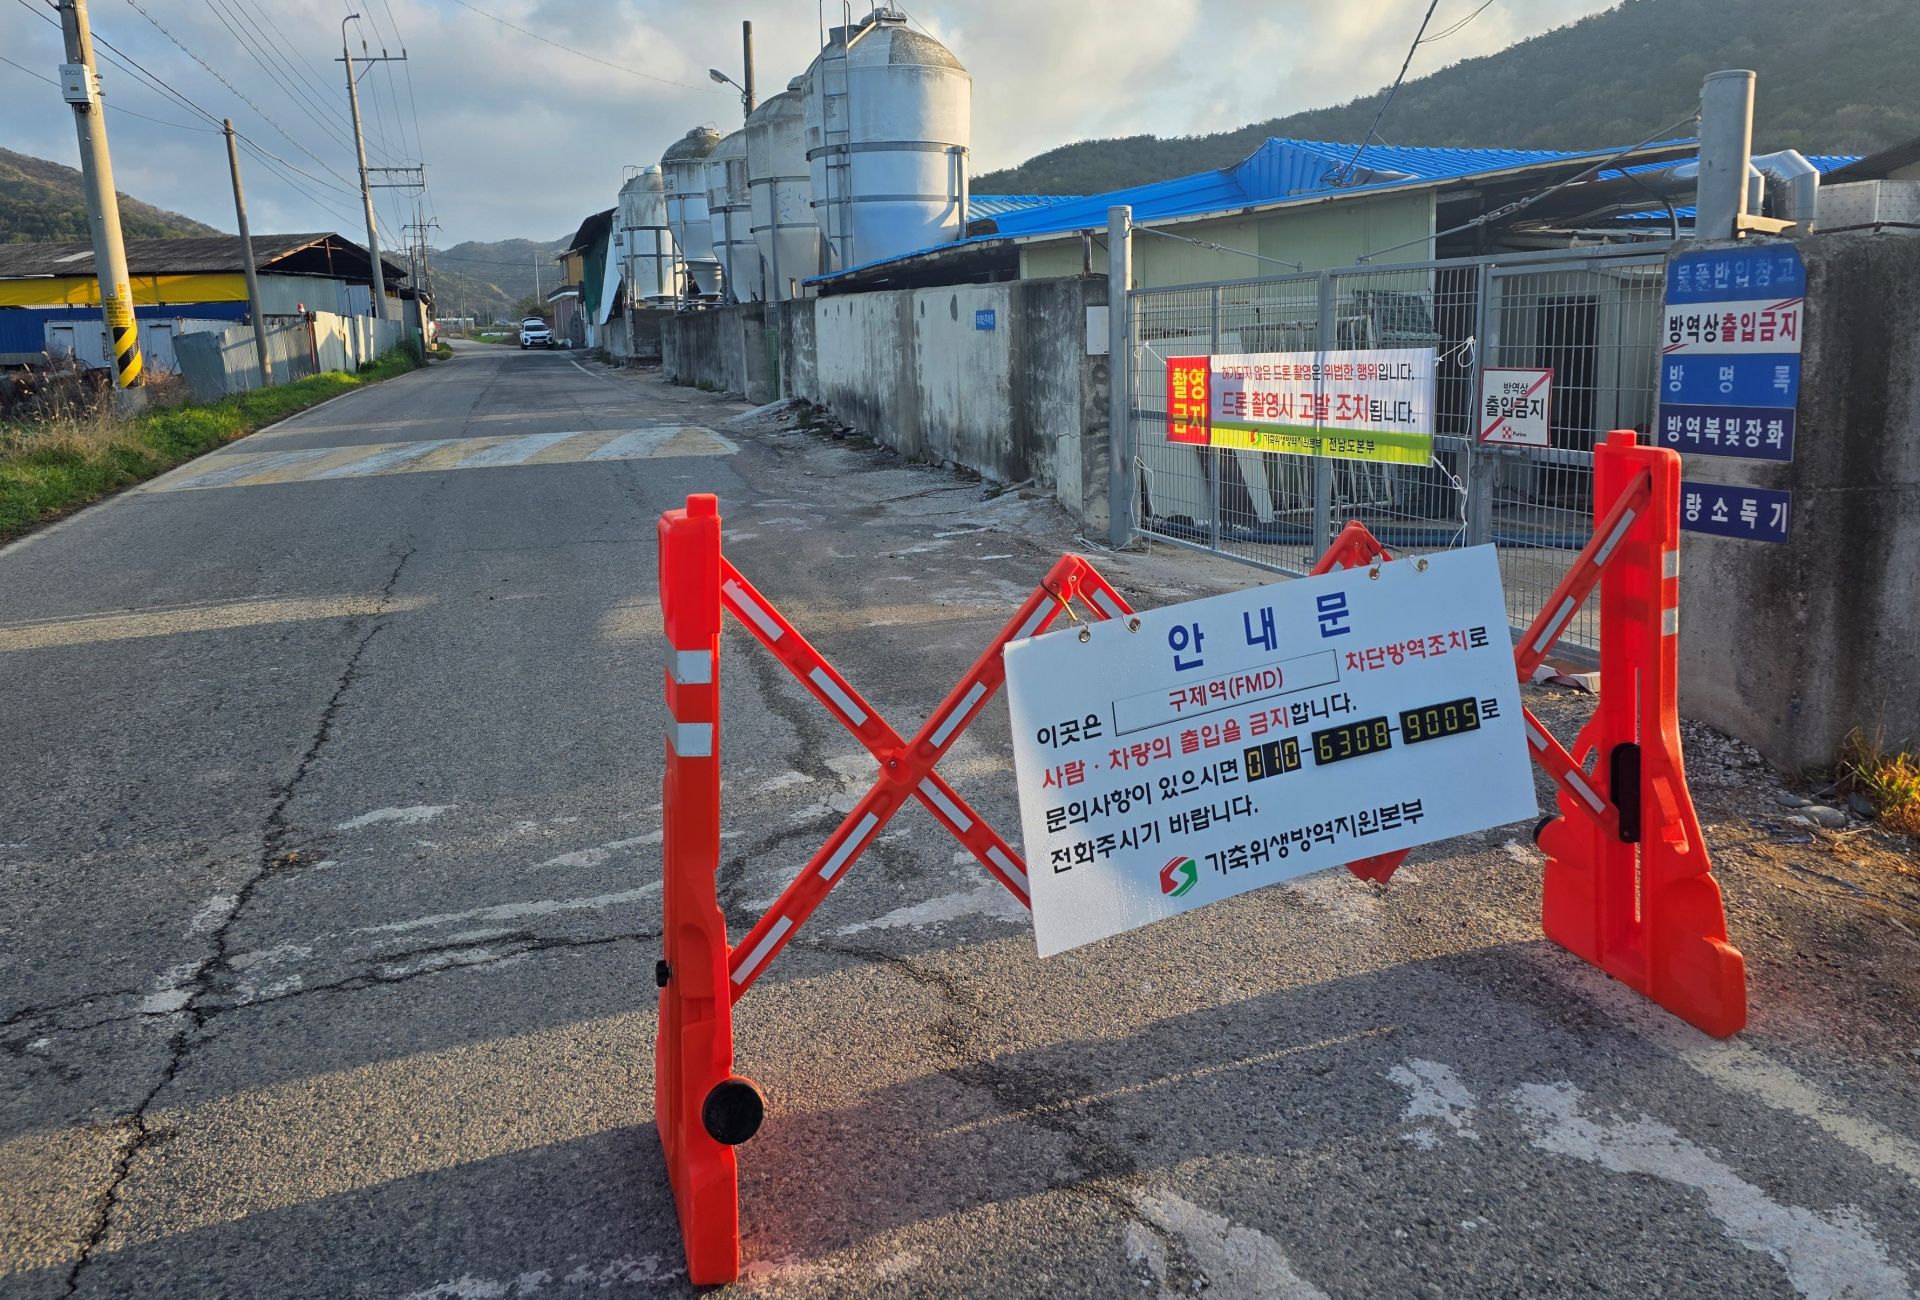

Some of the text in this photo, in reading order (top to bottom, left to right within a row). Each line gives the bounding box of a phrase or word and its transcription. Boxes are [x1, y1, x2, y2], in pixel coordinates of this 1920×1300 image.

[1669, 310, 1798, 344] 방역상출입금지
[1173, 367, 1205, 400] 촬영
[1254, 366, 1271, 381] 않은
[1273, 364, 1291, 381] 드론
[1293, 363, 1321, 381] 촬영은
[1324, 363, 1353, 381] 위법한
[1356, 363, 1415, 381] 행위입니다.
[1503, 382, 1528, 395] 방역상
[1173, 403, 1205, 435] 금지
[1222, 390, 1416, 424] 드론 촬영시 고발 조치됩니다.
[1485, 394, 1544, 420] 출입금지
[1329, 437, 1376, 455] 전남도본부
[1667, 415, 1784, 449] 방역복및장화
[1037, 626, 1489, 749] 이곳은 구제역(FMD) 차단방역조치로
[1042, 759, 1086, 789] 사람
[1108, 736, 1172, 770] 차량의
[1180, 718, 1242, 755] 출입을
[1249, 692, 1357, 737] 금지합니다.
[1046, 782, 1152, 834] 문의사항이
[1158, 758, 1239, 801] 있으시면
[1051, 794, 1259, 874] 전화주시기 바랍니다.
[1204, 799, 1425, 875] 가축위생방역지원본부
